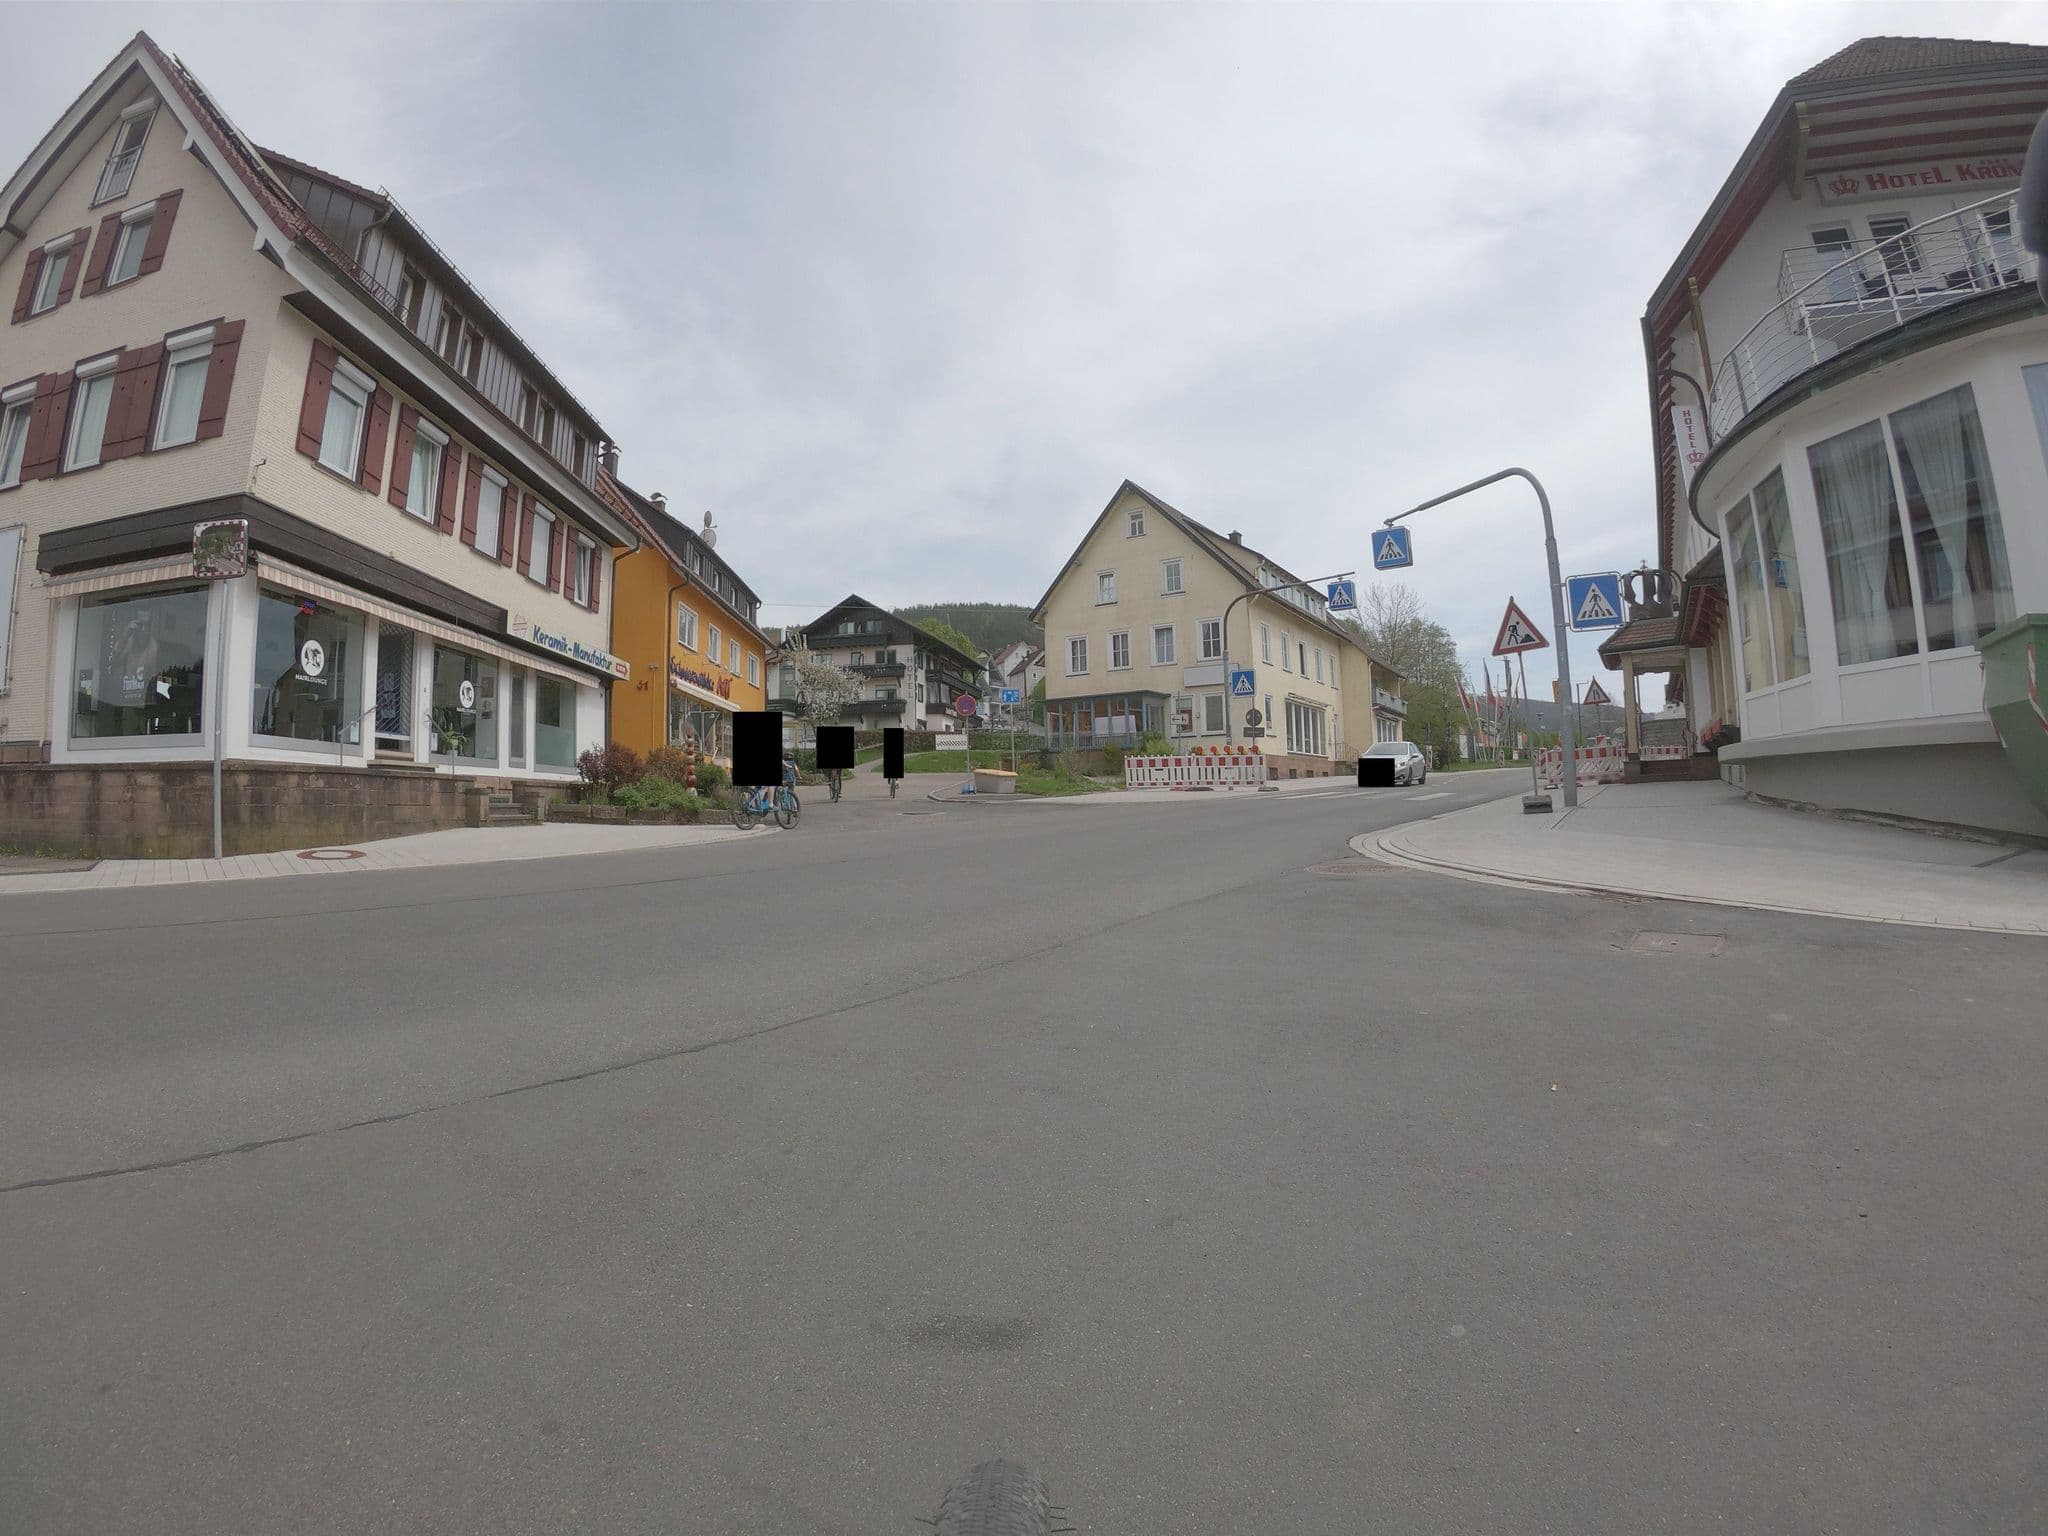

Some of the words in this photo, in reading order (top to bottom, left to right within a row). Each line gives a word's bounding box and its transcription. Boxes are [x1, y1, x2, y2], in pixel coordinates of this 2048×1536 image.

[1866, 167, 1952, 191] HOTEL
[1957, 164, 2022, 181] KRON
[1683, 410, 1696, 448] HOTEL
[533, 625, 612, 671] Keramik-Manufaktur
